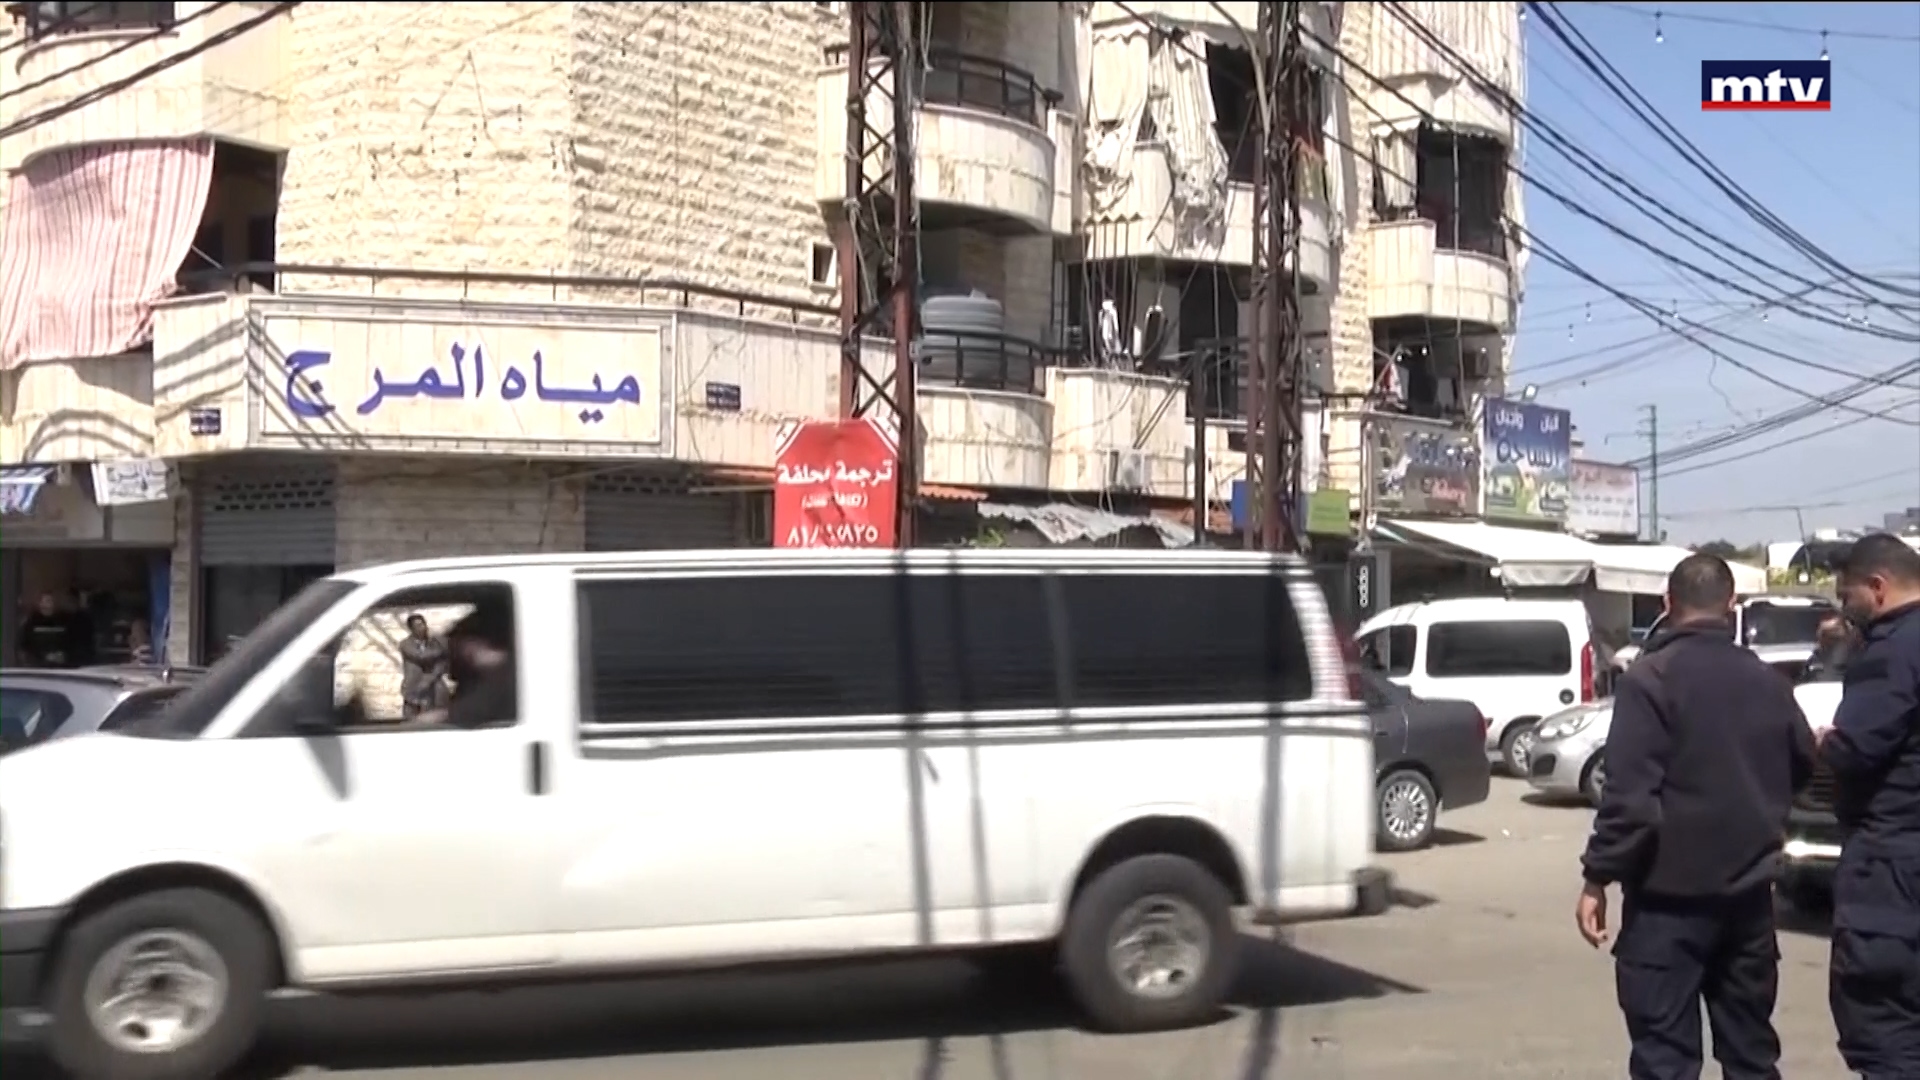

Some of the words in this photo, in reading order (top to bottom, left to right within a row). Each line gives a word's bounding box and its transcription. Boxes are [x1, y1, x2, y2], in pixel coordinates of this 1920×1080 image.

[285, 342, 483, 418] المرج
[500, 349, 641, 424] مياه
[835, 459, 893, 488] ترجمة
